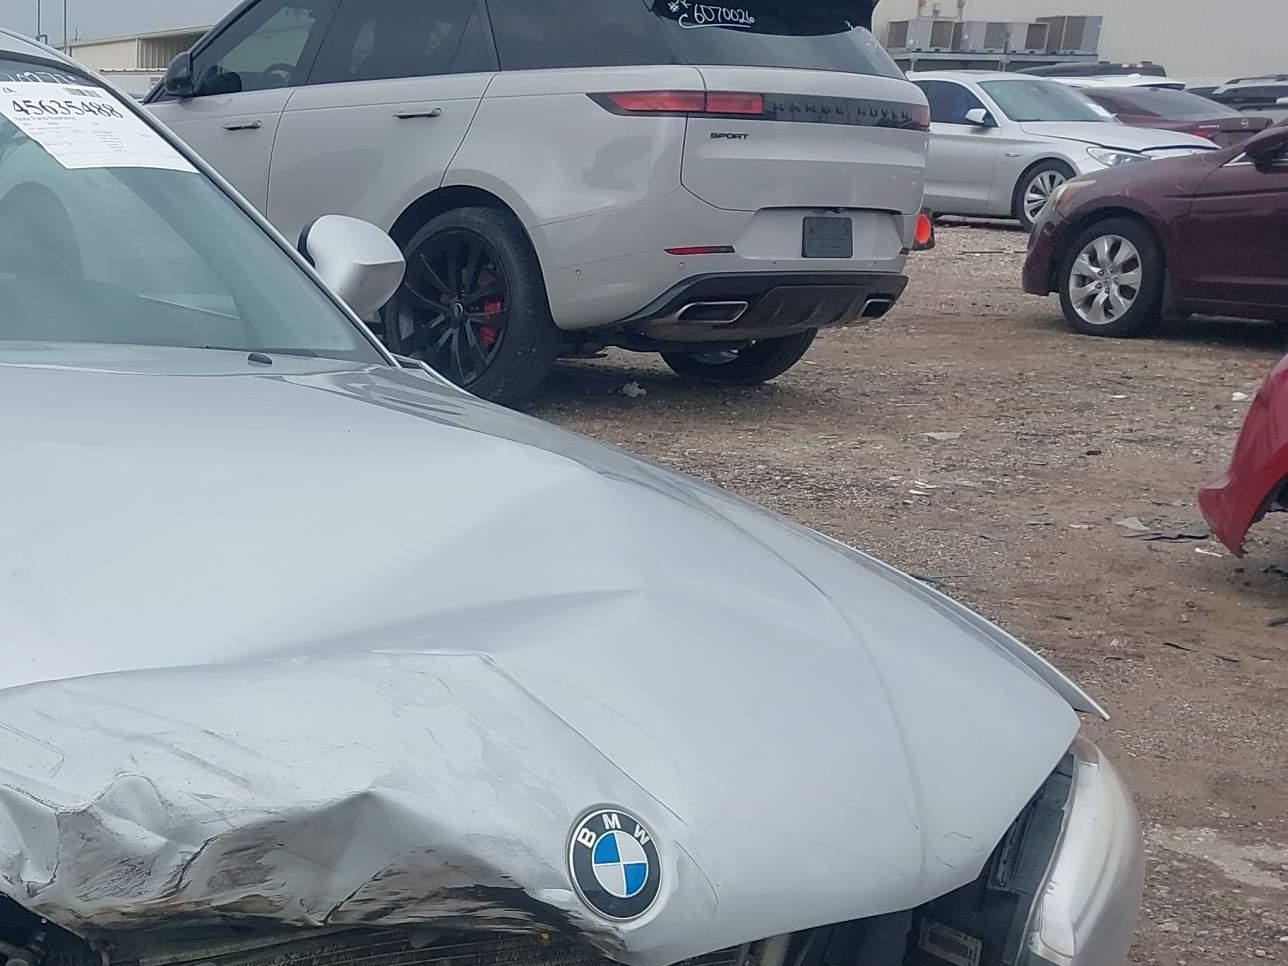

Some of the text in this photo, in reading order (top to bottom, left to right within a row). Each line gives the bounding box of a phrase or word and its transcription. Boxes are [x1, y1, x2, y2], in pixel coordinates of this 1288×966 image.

[12, 99, 123, 118] 45635488
[710, 132, 749, 140] SPORT
[576, 813, 650, 849] BMW
